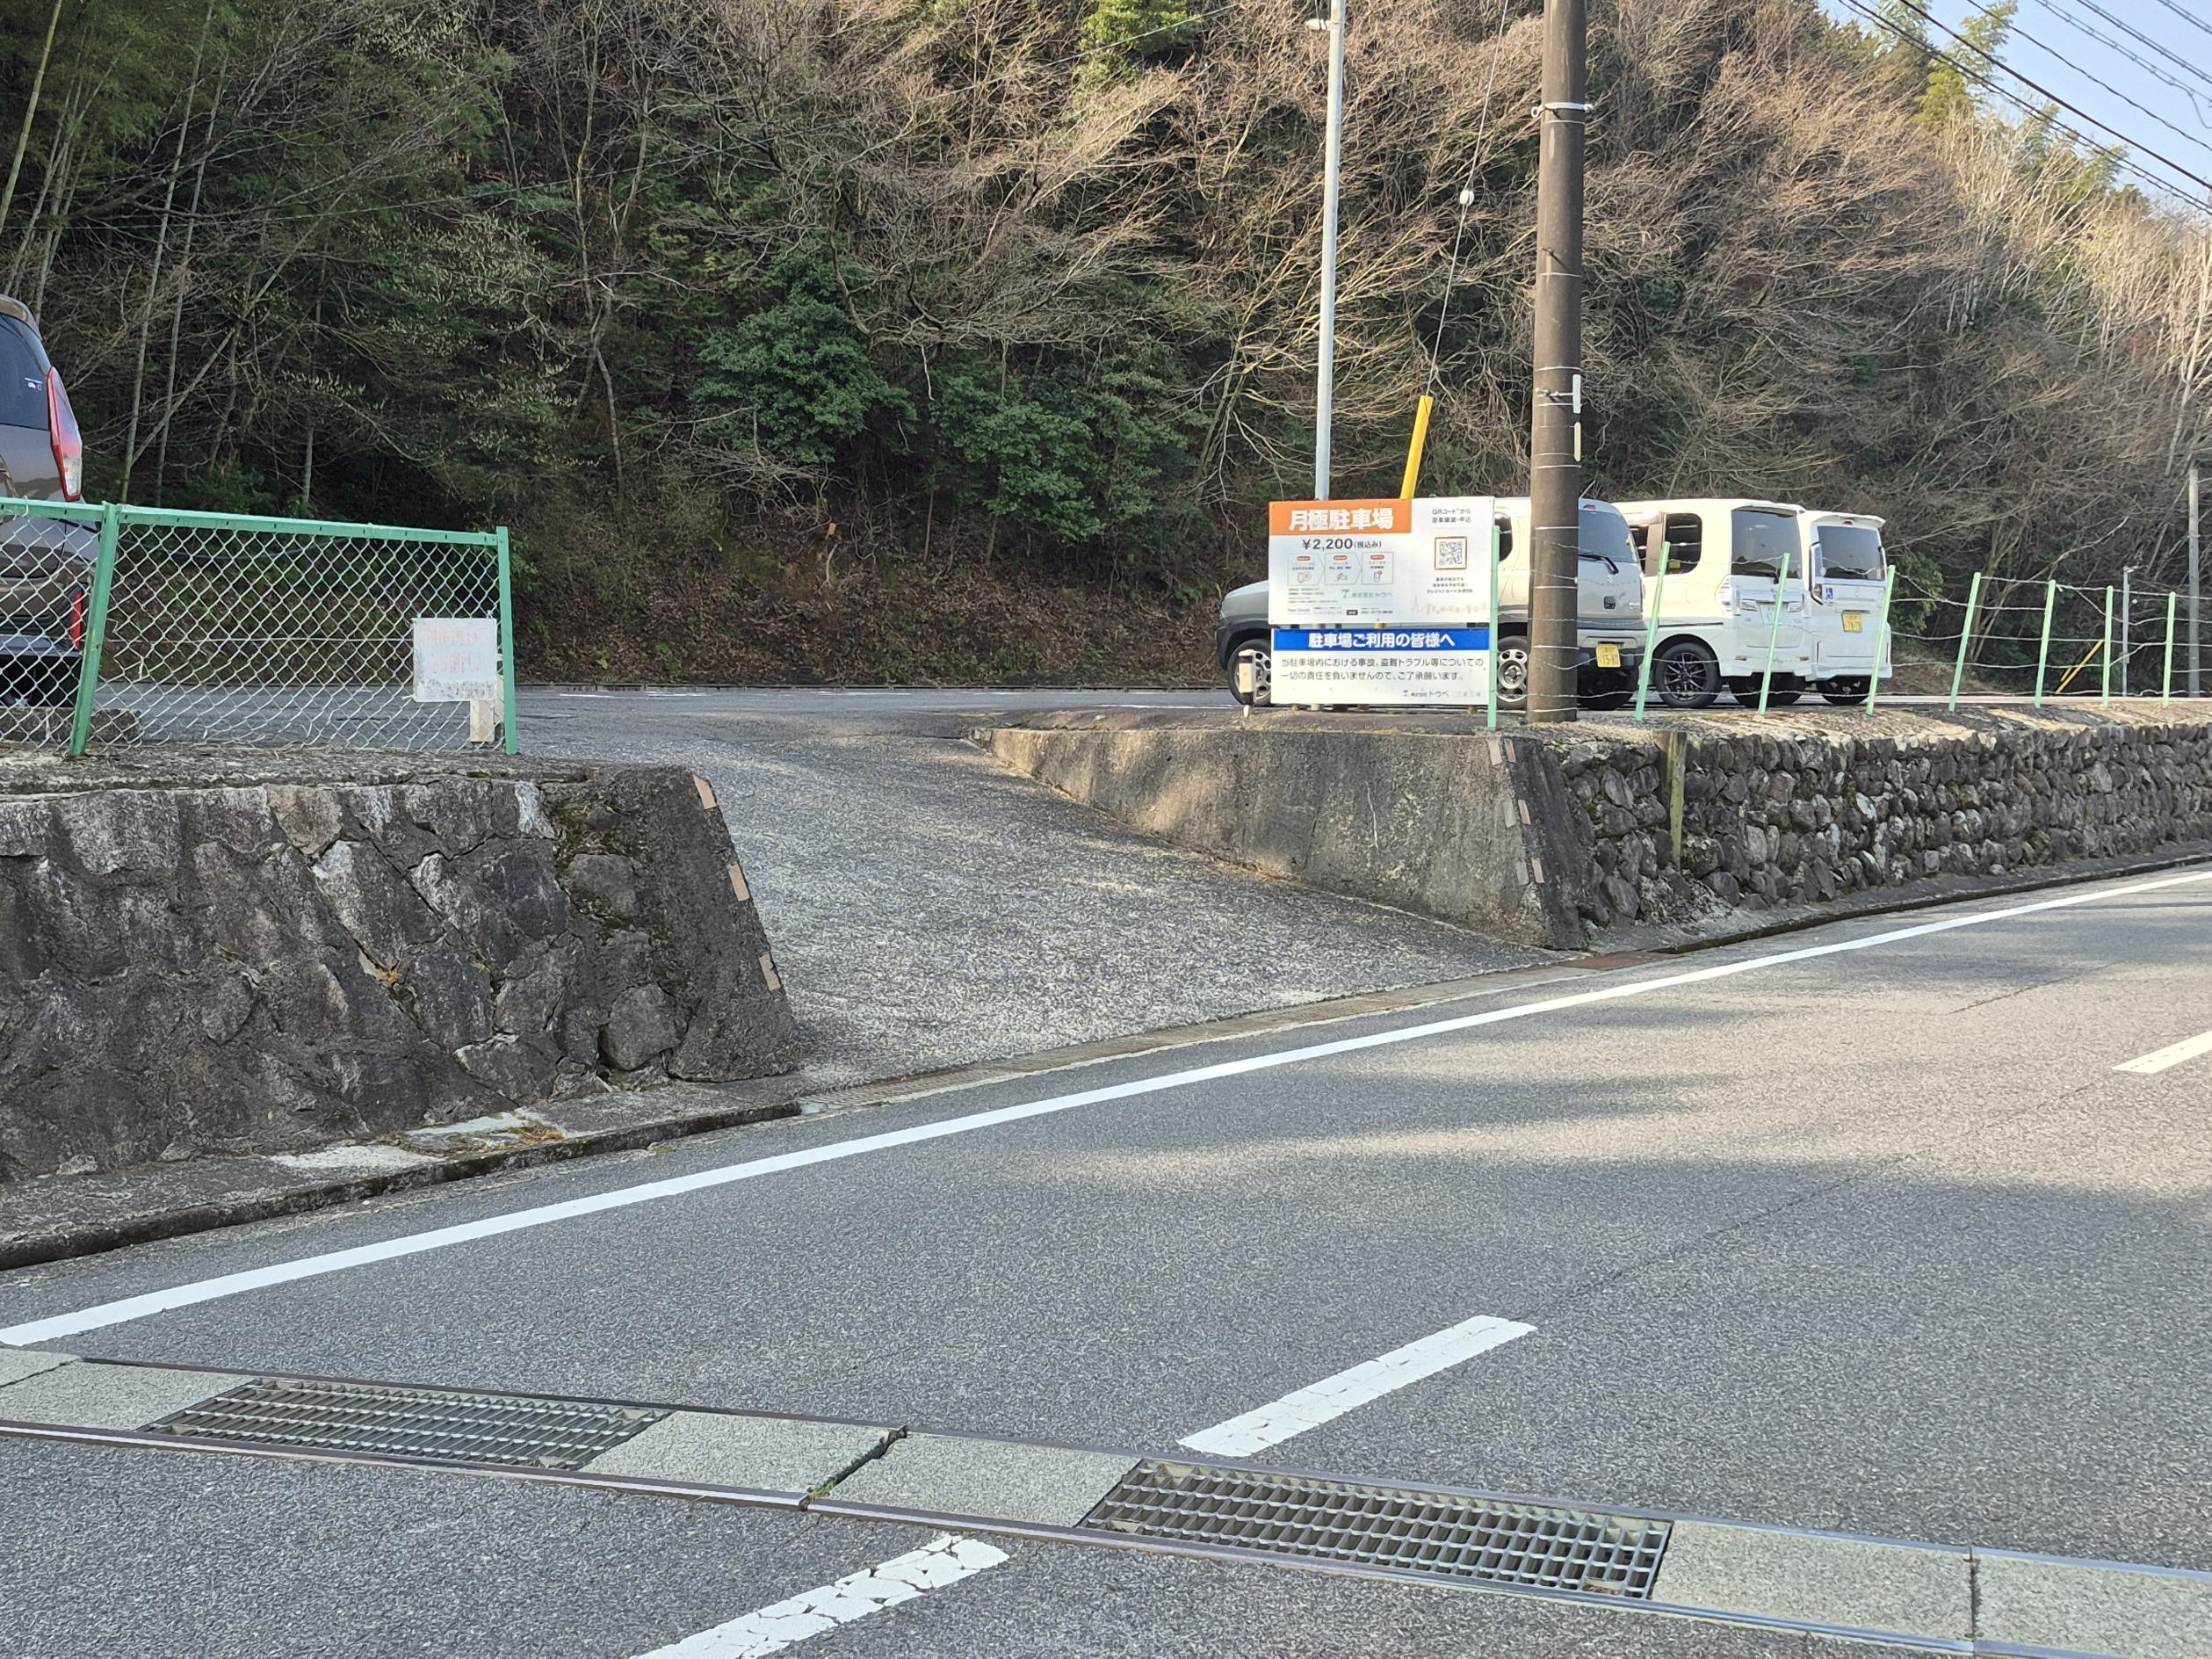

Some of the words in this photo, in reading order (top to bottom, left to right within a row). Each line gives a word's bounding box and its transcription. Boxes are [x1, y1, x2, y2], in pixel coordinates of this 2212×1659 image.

[1289, 507, 1394, 532] 月極駐車場
[1308, 633, 1456, 648] 駐車場ご利用の皆様へ
[1281, 657, 1484, 668] 当駐車場内における事故、盗難トラブル等についての
